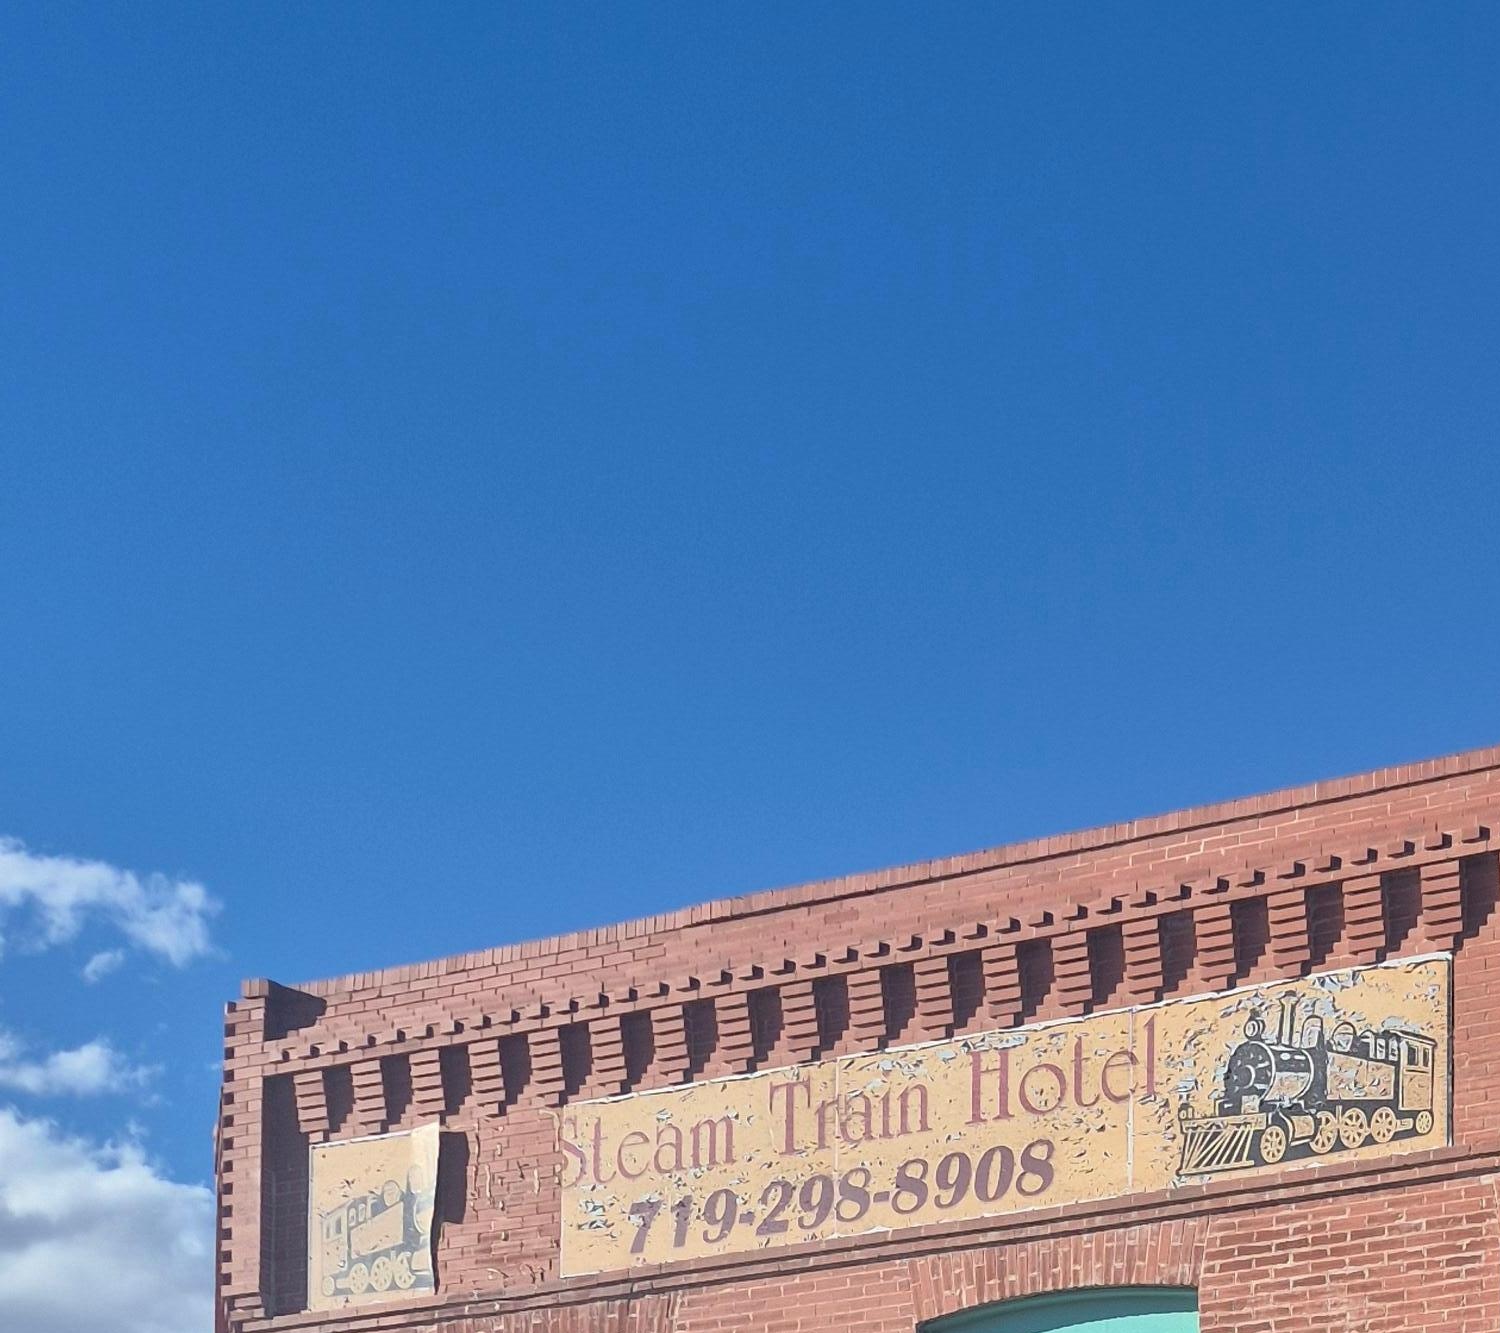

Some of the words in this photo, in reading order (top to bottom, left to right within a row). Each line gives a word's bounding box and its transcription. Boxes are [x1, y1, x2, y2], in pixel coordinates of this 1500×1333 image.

[559, 1113, 738, 1189] Steam
[768, 1073, 932, 1156] Train
[964, 1013, 1157, 1127] Hotel
[628, 1139, 1056, 1254] 719-298-8908
